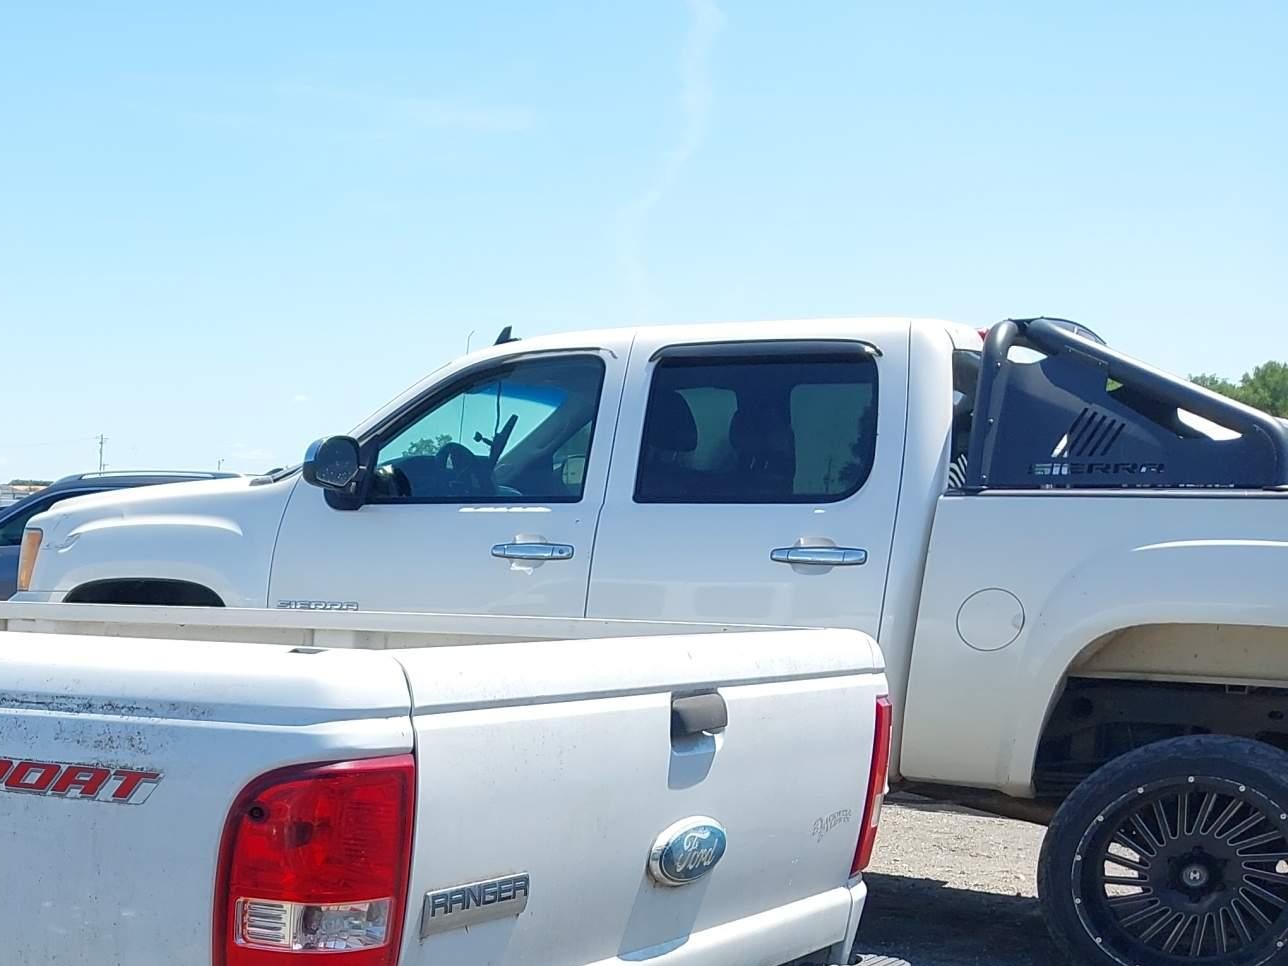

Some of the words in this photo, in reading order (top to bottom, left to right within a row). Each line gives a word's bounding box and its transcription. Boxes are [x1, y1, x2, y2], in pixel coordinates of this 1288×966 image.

[1027, 463, 1165, 476] SIERRA
[277, 600, 359, 611] SIERRA
[674, 831, 720, 873] Ford
[430, 876, 528, 917] RANGER
